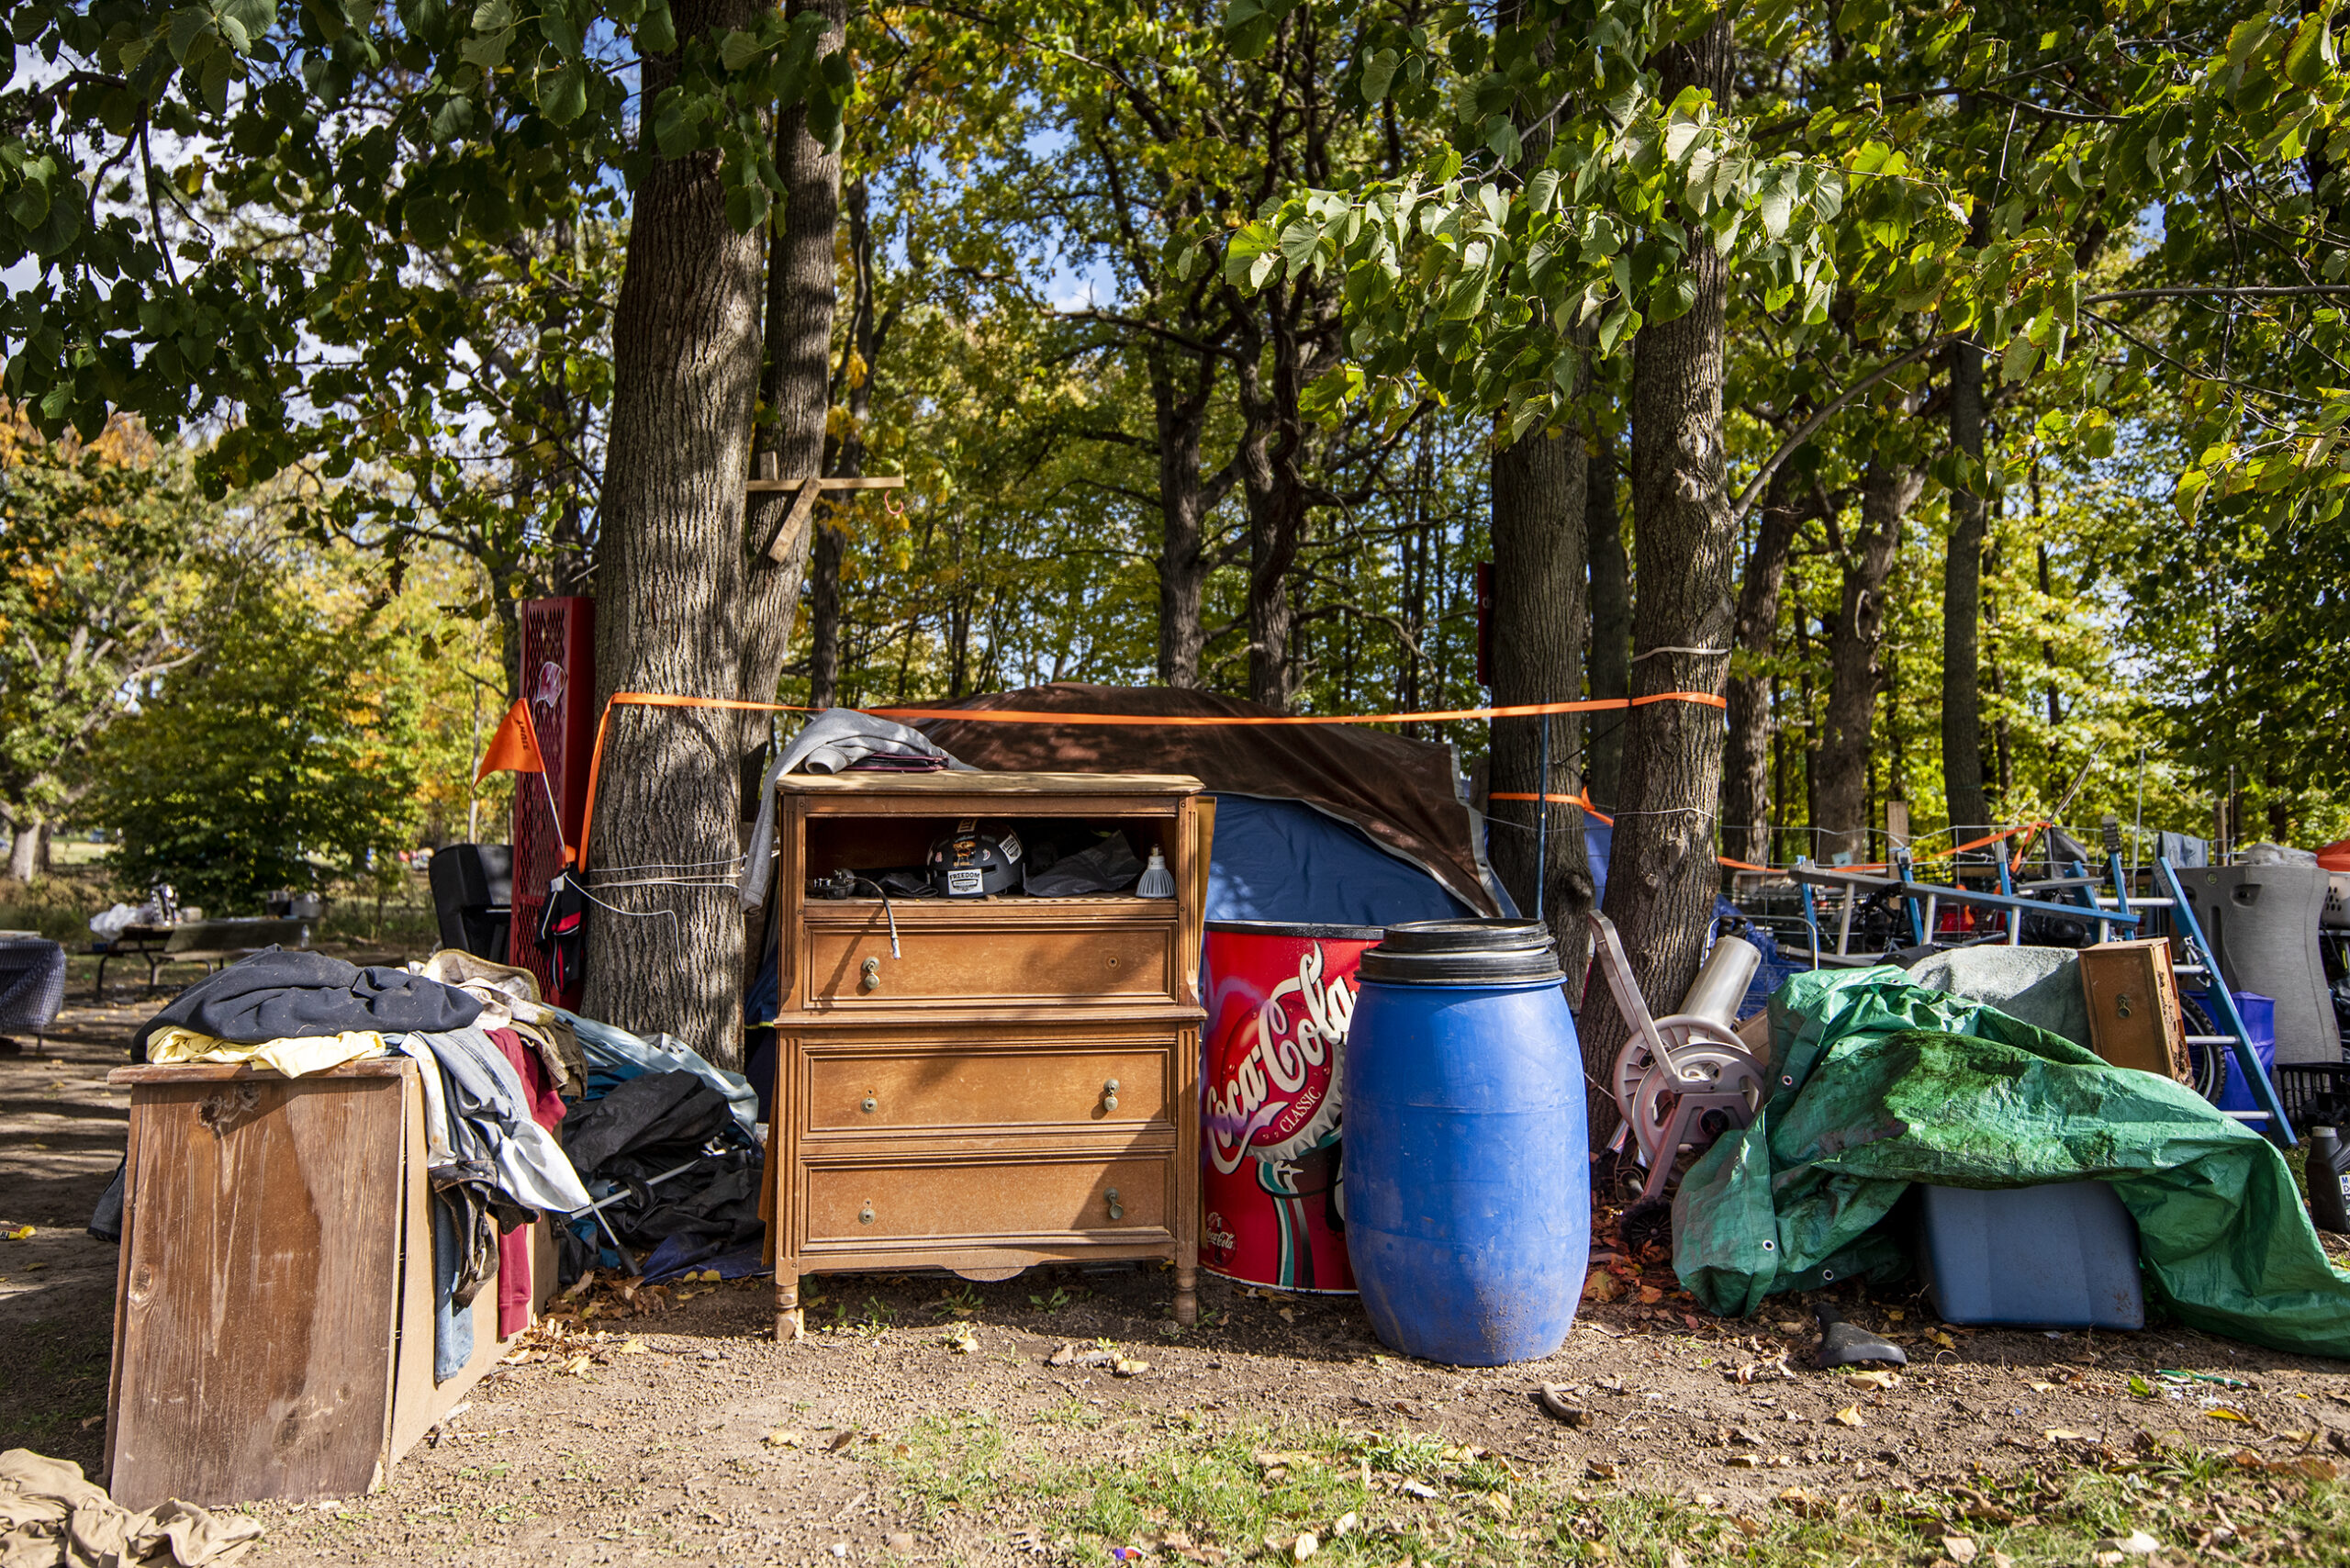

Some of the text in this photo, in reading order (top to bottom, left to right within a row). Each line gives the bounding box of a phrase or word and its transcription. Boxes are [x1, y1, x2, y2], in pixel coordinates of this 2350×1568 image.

[949, 871, 980, 879] FREEDOM
[1206, 940, 1358, 1174] Coca-Cola
[1279, 1086, 1322, 1133] CLASSIC
